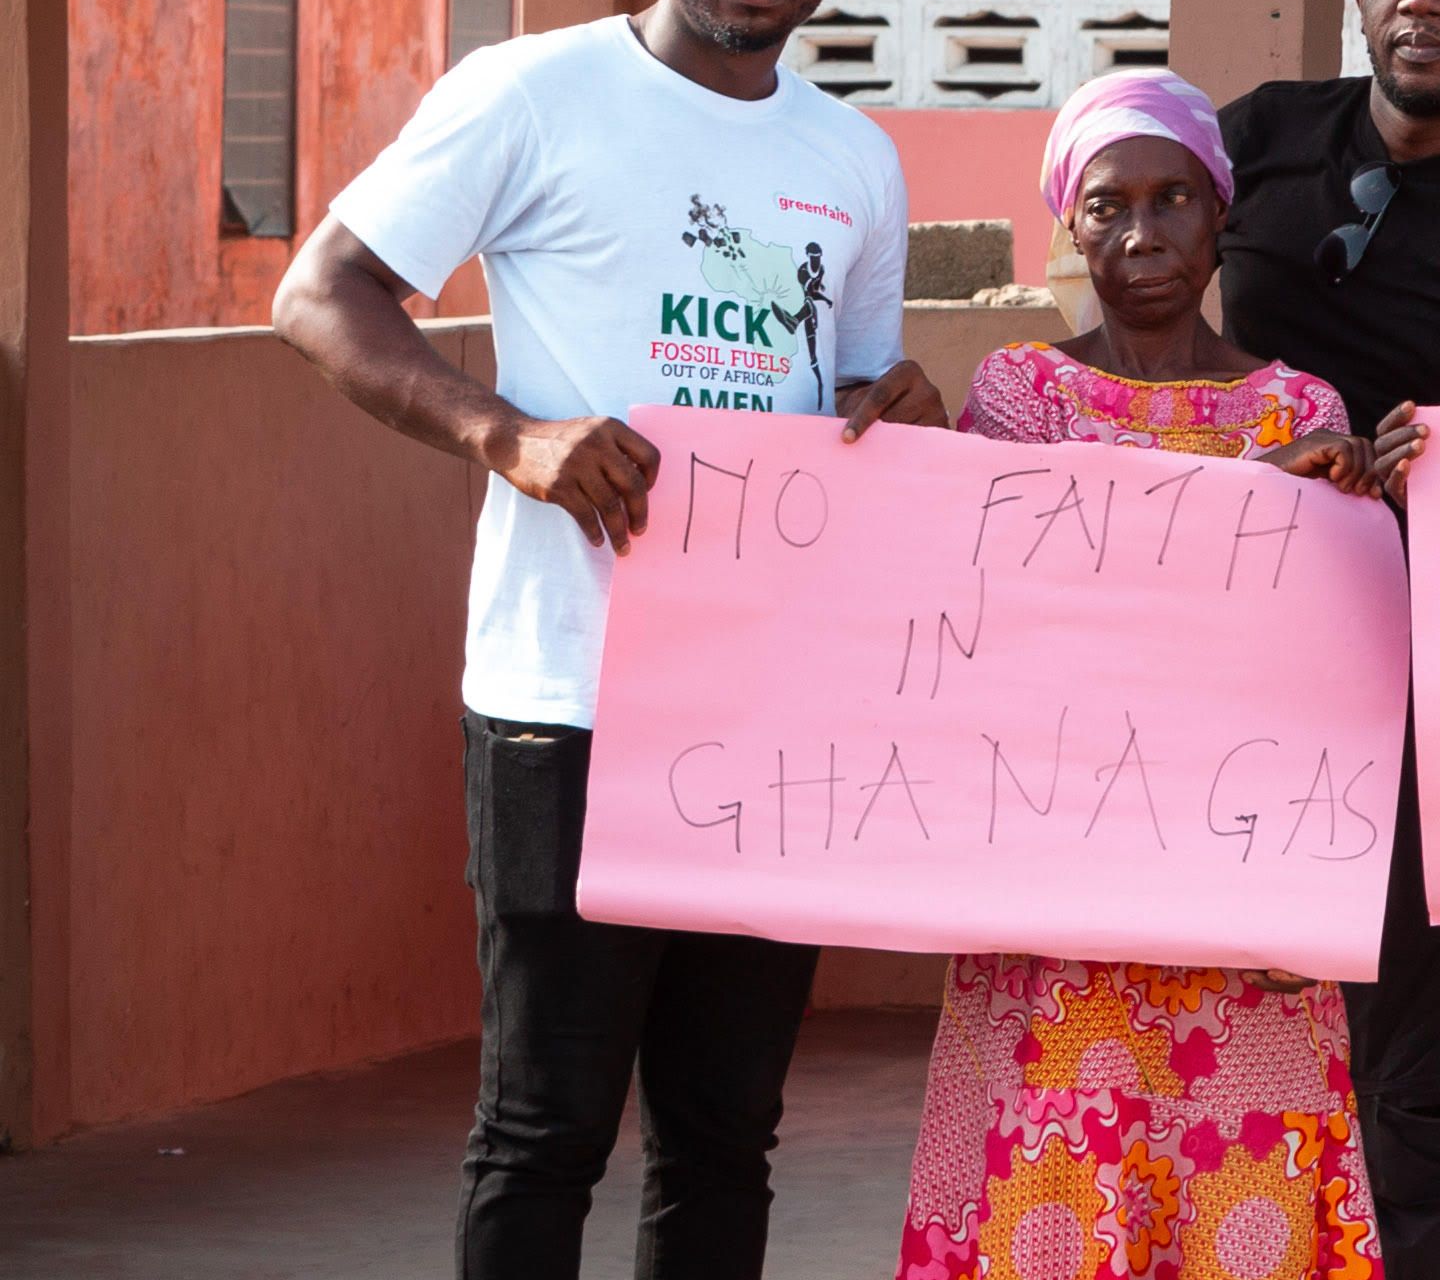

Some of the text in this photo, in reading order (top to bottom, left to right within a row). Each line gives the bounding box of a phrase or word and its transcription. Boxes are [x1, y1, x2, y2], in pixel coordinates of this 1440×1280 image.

[779, 197, 853, 227] greenfaith
[661, 293, 773, 348] KICK
[650, 341, 791, 375] FOSSIL FUELS
[661, 363, 775, 387] OUT OF AFRICA
[683, 452, 1303, 590] NO FAITH
[896, 568, 985, 700] IN
[668, 706, 1378, 862] GHANA GAS
